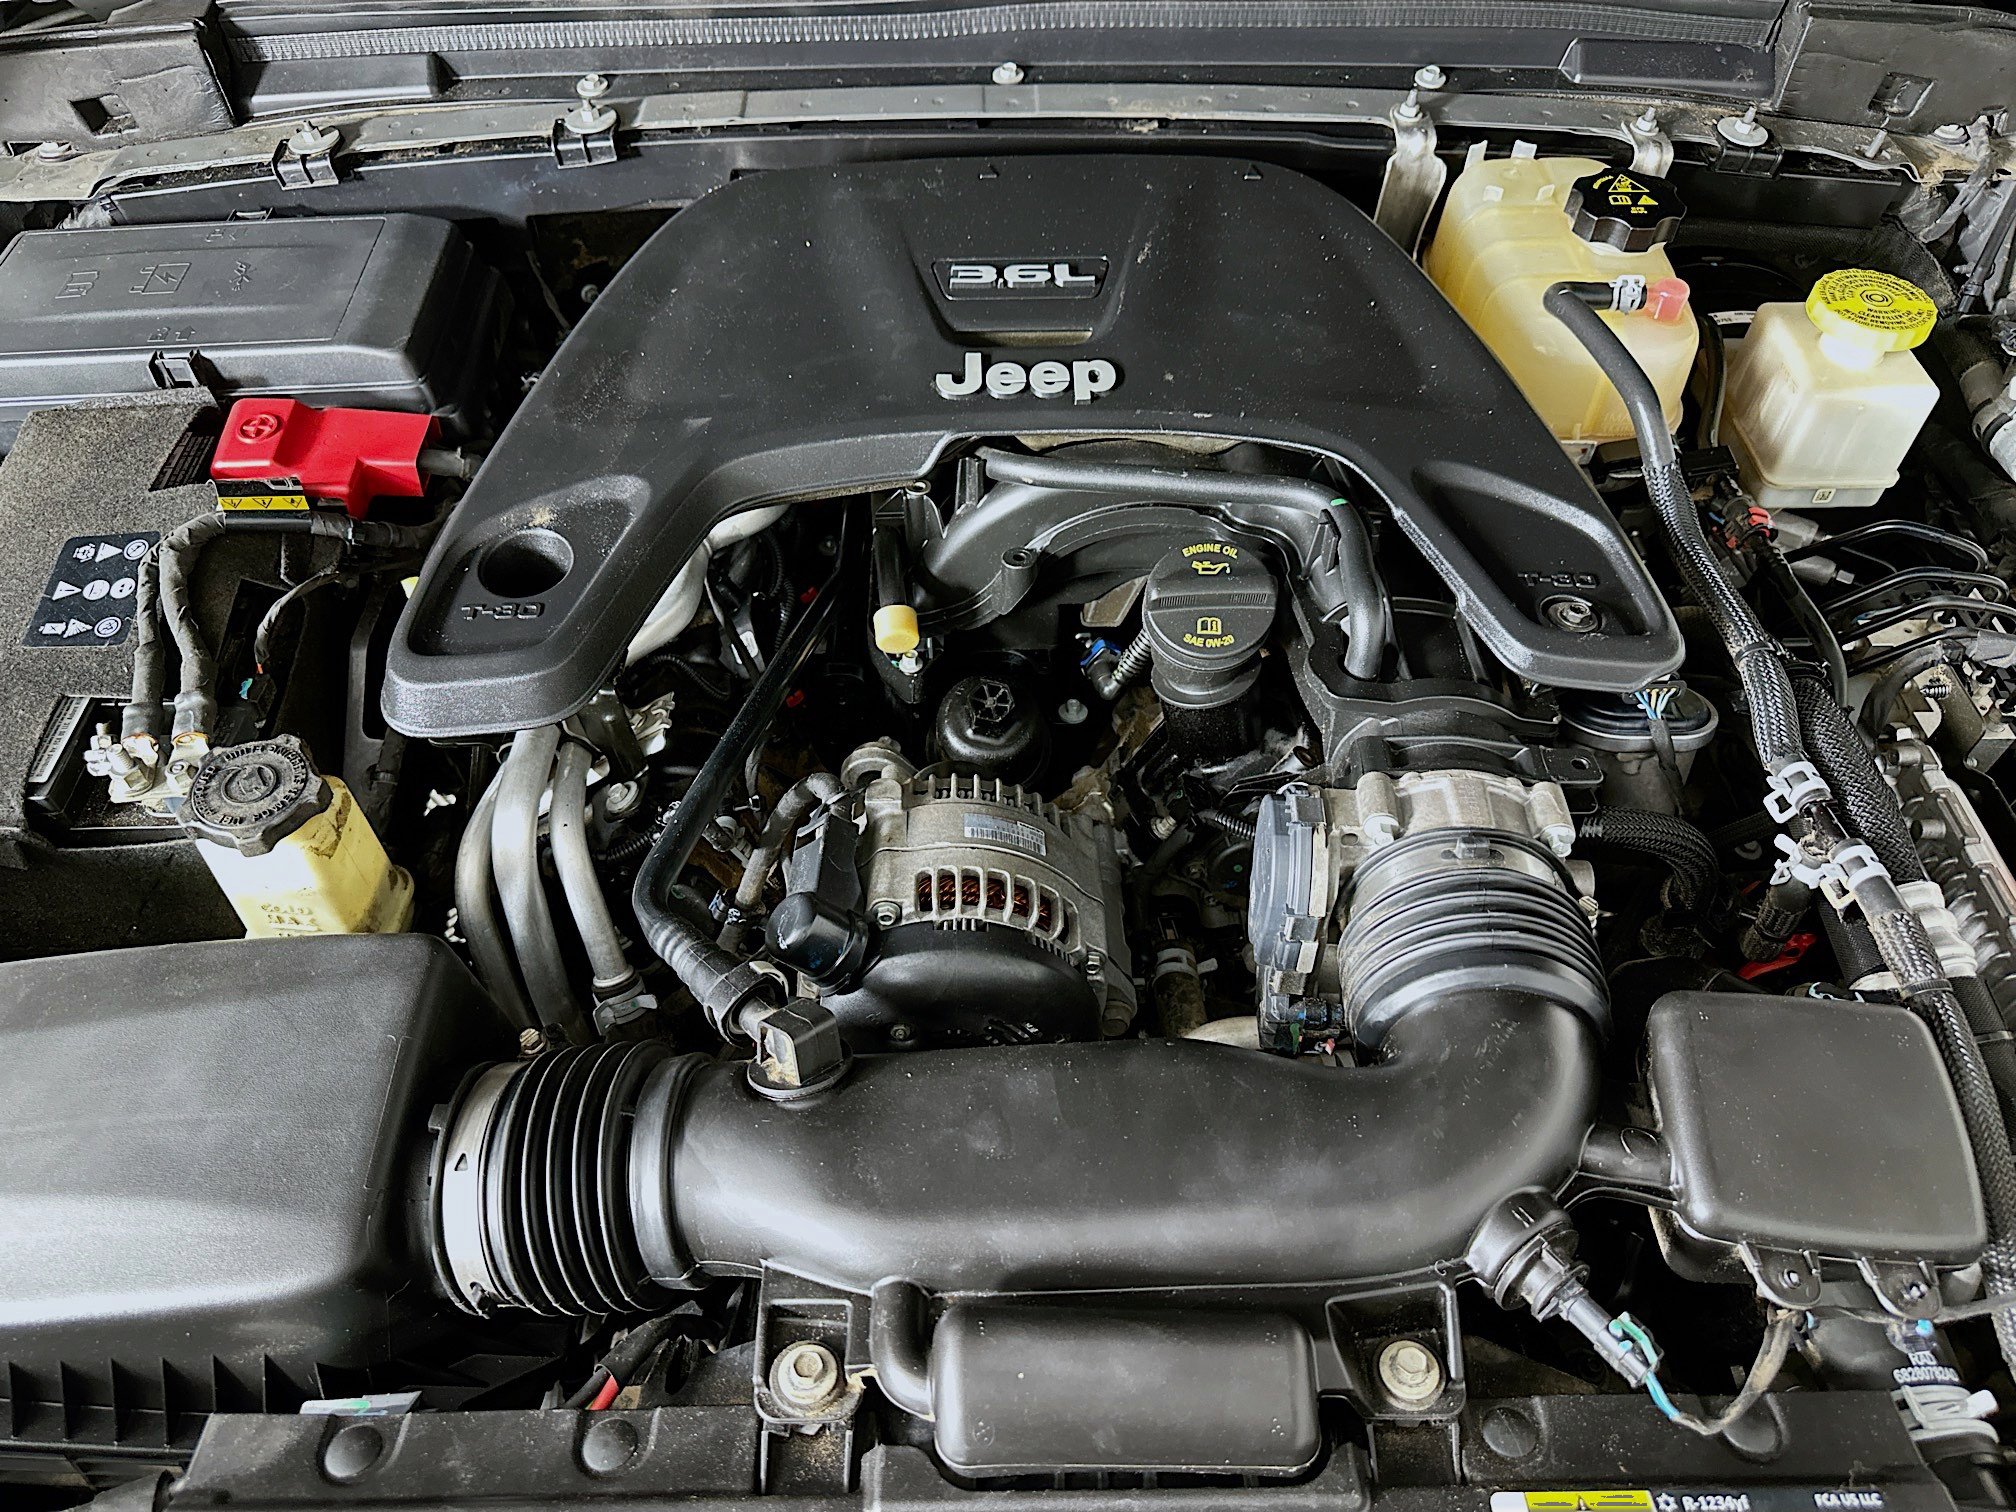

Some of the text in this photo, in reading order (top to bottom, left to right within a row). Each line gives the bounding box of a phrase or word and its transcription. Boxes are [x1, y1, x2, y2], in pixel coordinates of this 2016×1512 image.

[949, 263, 1096, 289] 3.6L
[935, 351, 1117, 406] Jeep
[1182, 543, 1238, 559] ENGINE OIL
[1183, 633, 1235, 648] SAE 0W-20
[1681, 1493, 1751, 1512] R-1234yf
[1813, 1491, 1884, 1508] FCA US LLC
